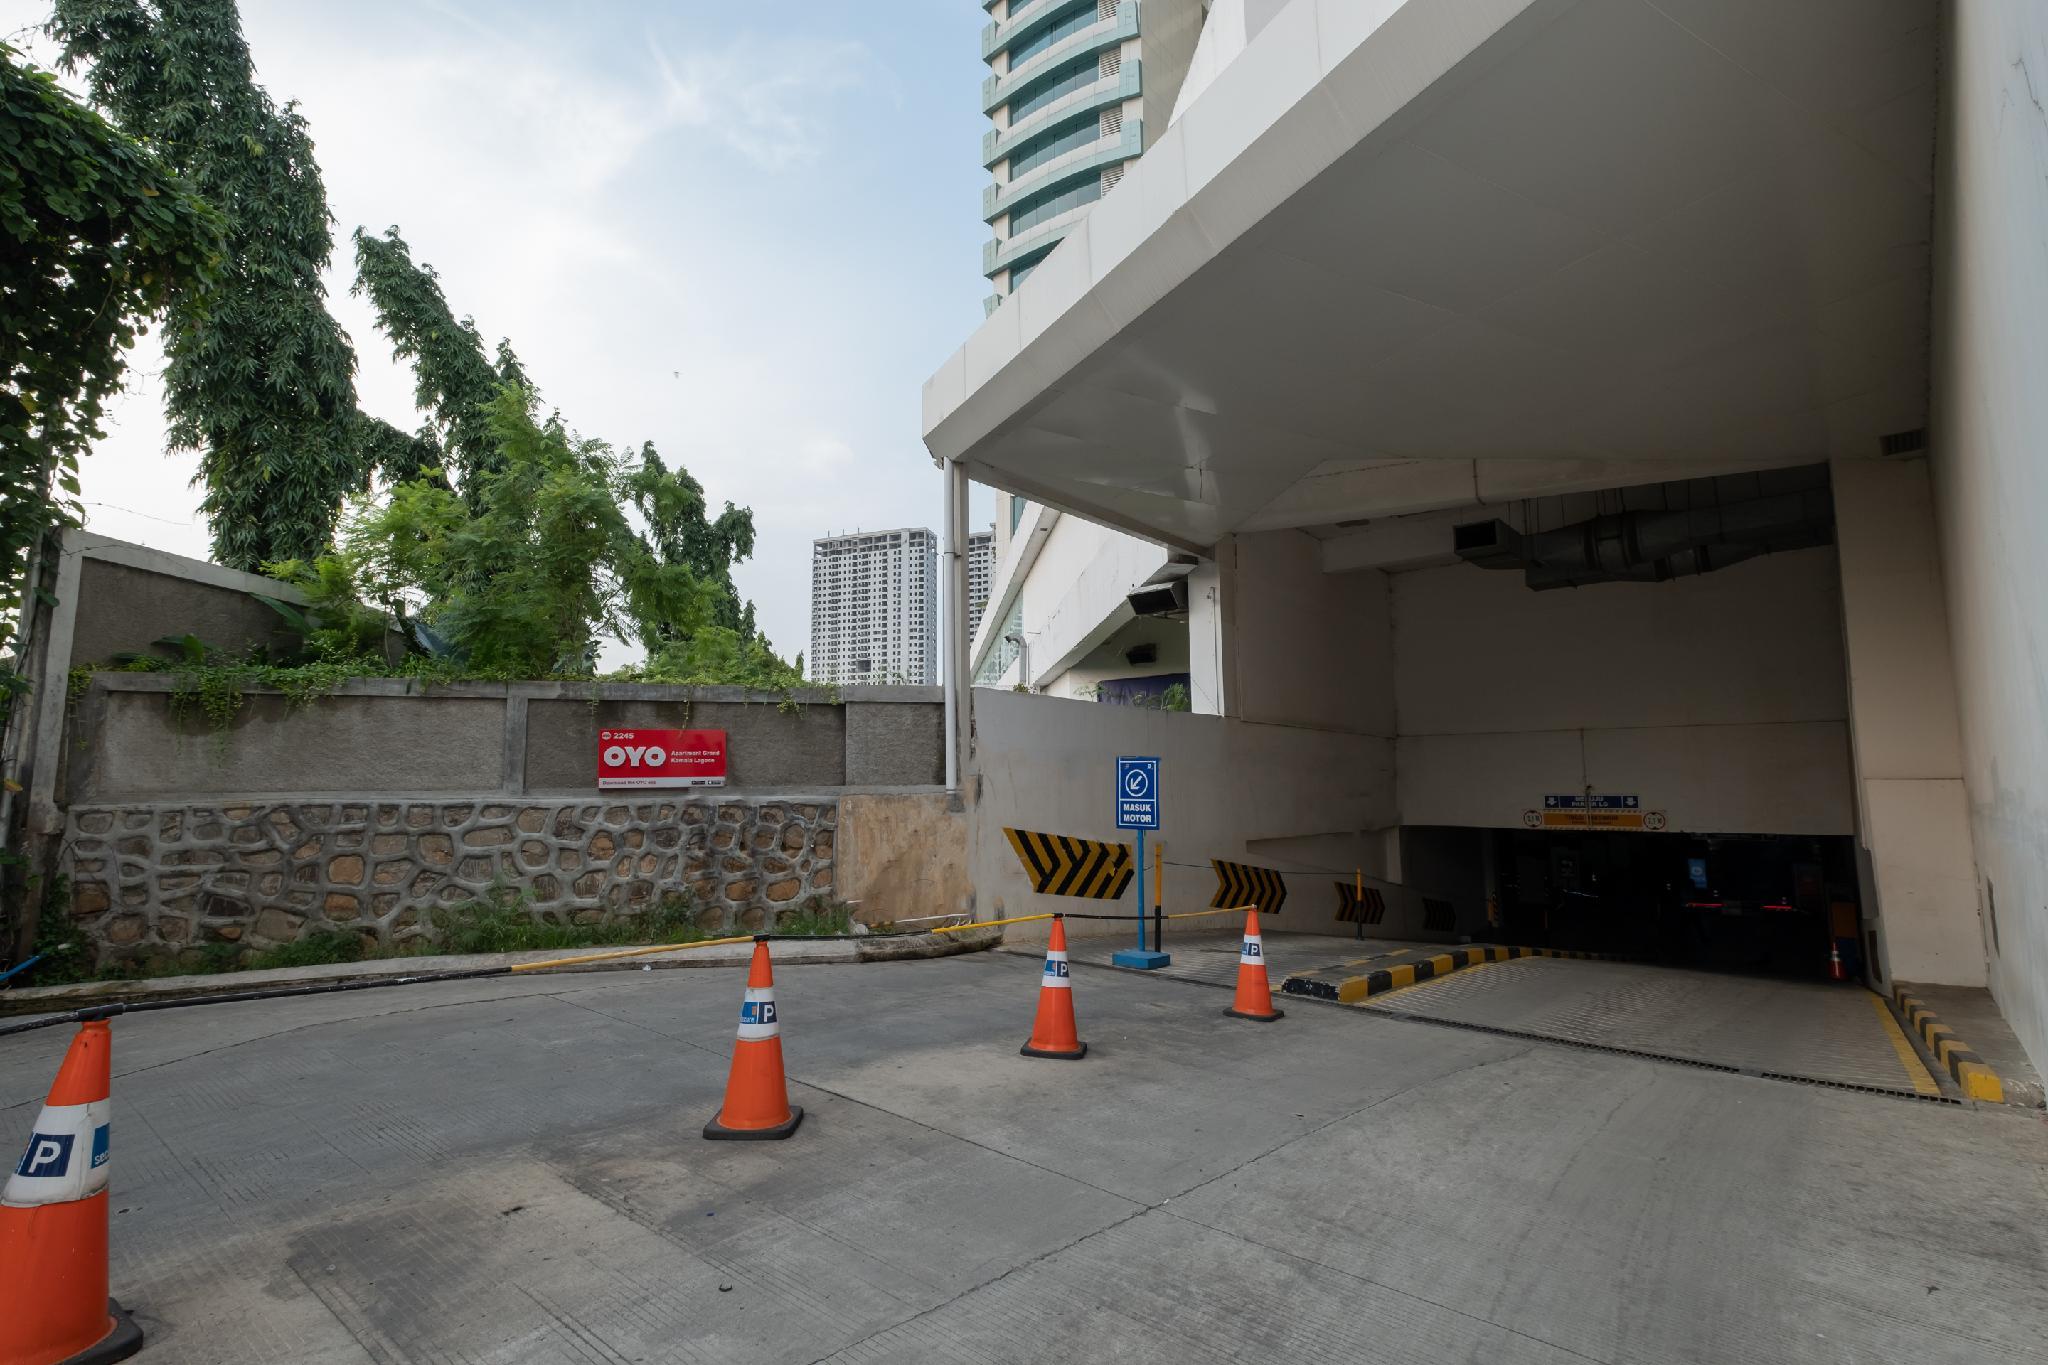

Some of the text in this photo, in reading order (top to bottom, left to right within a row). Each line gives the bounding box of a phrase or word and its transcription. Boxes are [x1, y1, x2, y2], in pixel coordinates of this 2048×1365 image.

[603, 746, 667, 767] OYO
[1123, 804, 1152, 812] MASUK
[1123, 814, 1152, 822] MOTOR
[1251, 945, 1259, 955] P
[1060, 963, 1068, 976] P
[763, 1004, 774, 1022] P
[27, 1140, 61, 1173] P
